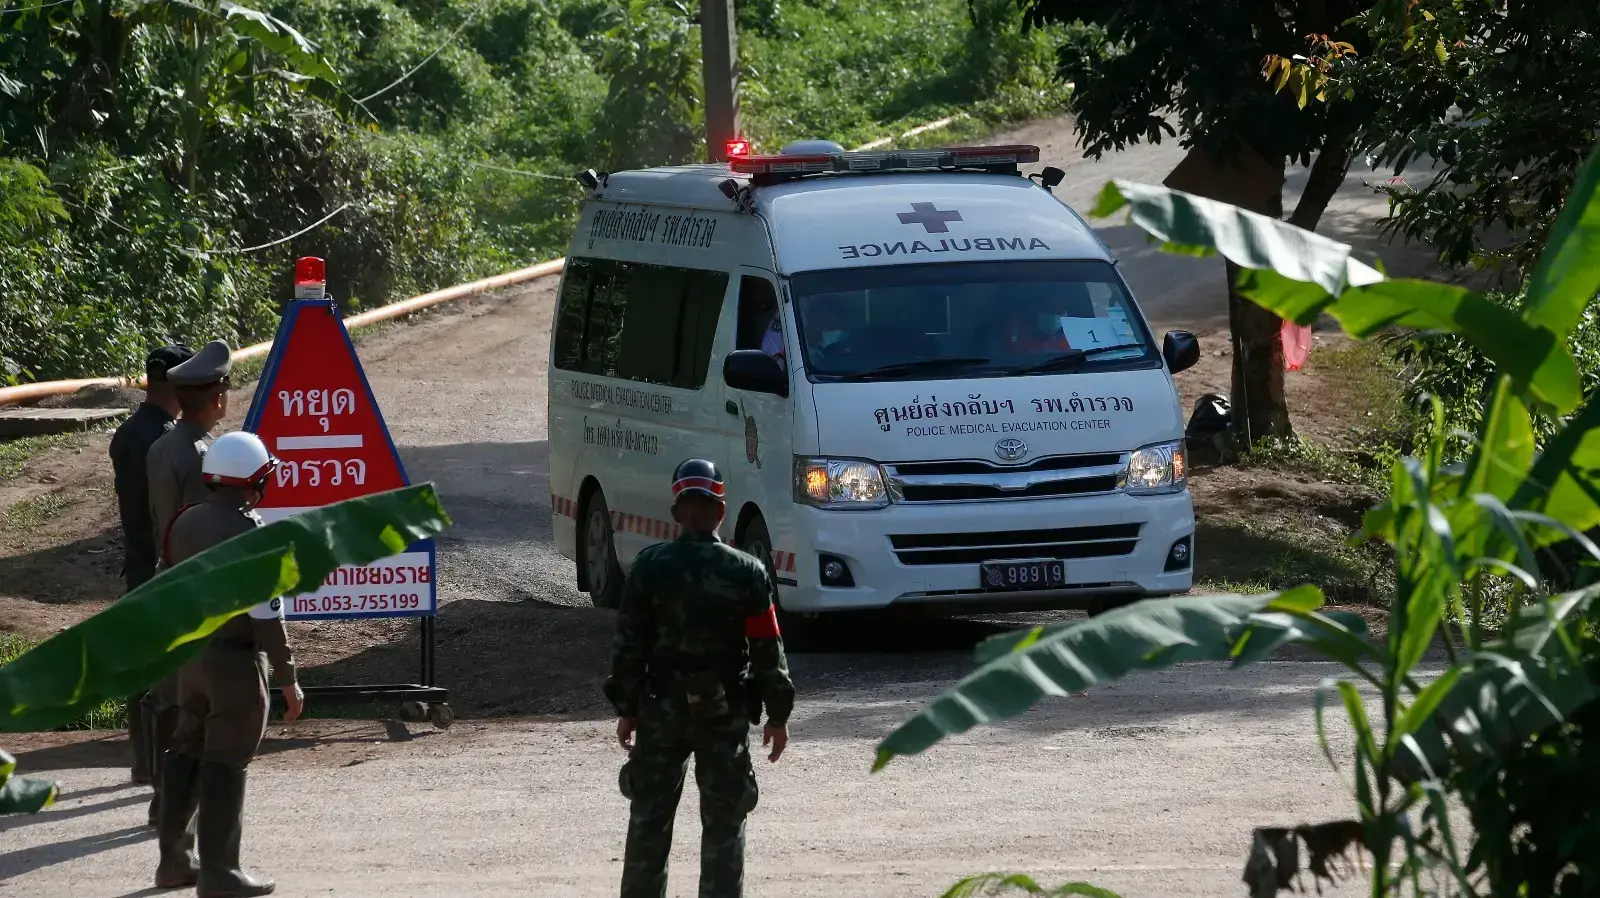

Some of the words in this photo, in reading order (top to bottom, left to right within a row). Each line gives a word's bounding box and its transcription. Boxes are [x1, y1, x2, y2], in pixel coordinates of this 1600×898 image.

[1087, 329, 1100, 343] 1
[278, 388, 356, 433] หยุด
[571, 380, 590, 399] POLICE
[590, 383, 614, 404] MEDICAL
[615, 387, 651, 409] EVACUATION
[650, 393, 673, 413] CENTER
[874, 393, 1015, 432] ศูนย์ส่งกลับฯ
[1030, 391, 1134, 414] รพ.ตำรวจ
[906, 426, 946, 437] POLICE
[949, 423, 999, 435] MEDICAL
[1002, 421, 1067, 433] EVACUATION
[1070, 419, 1112, 431] CENTER
[275, 458, 367, 488] ตรวจ
